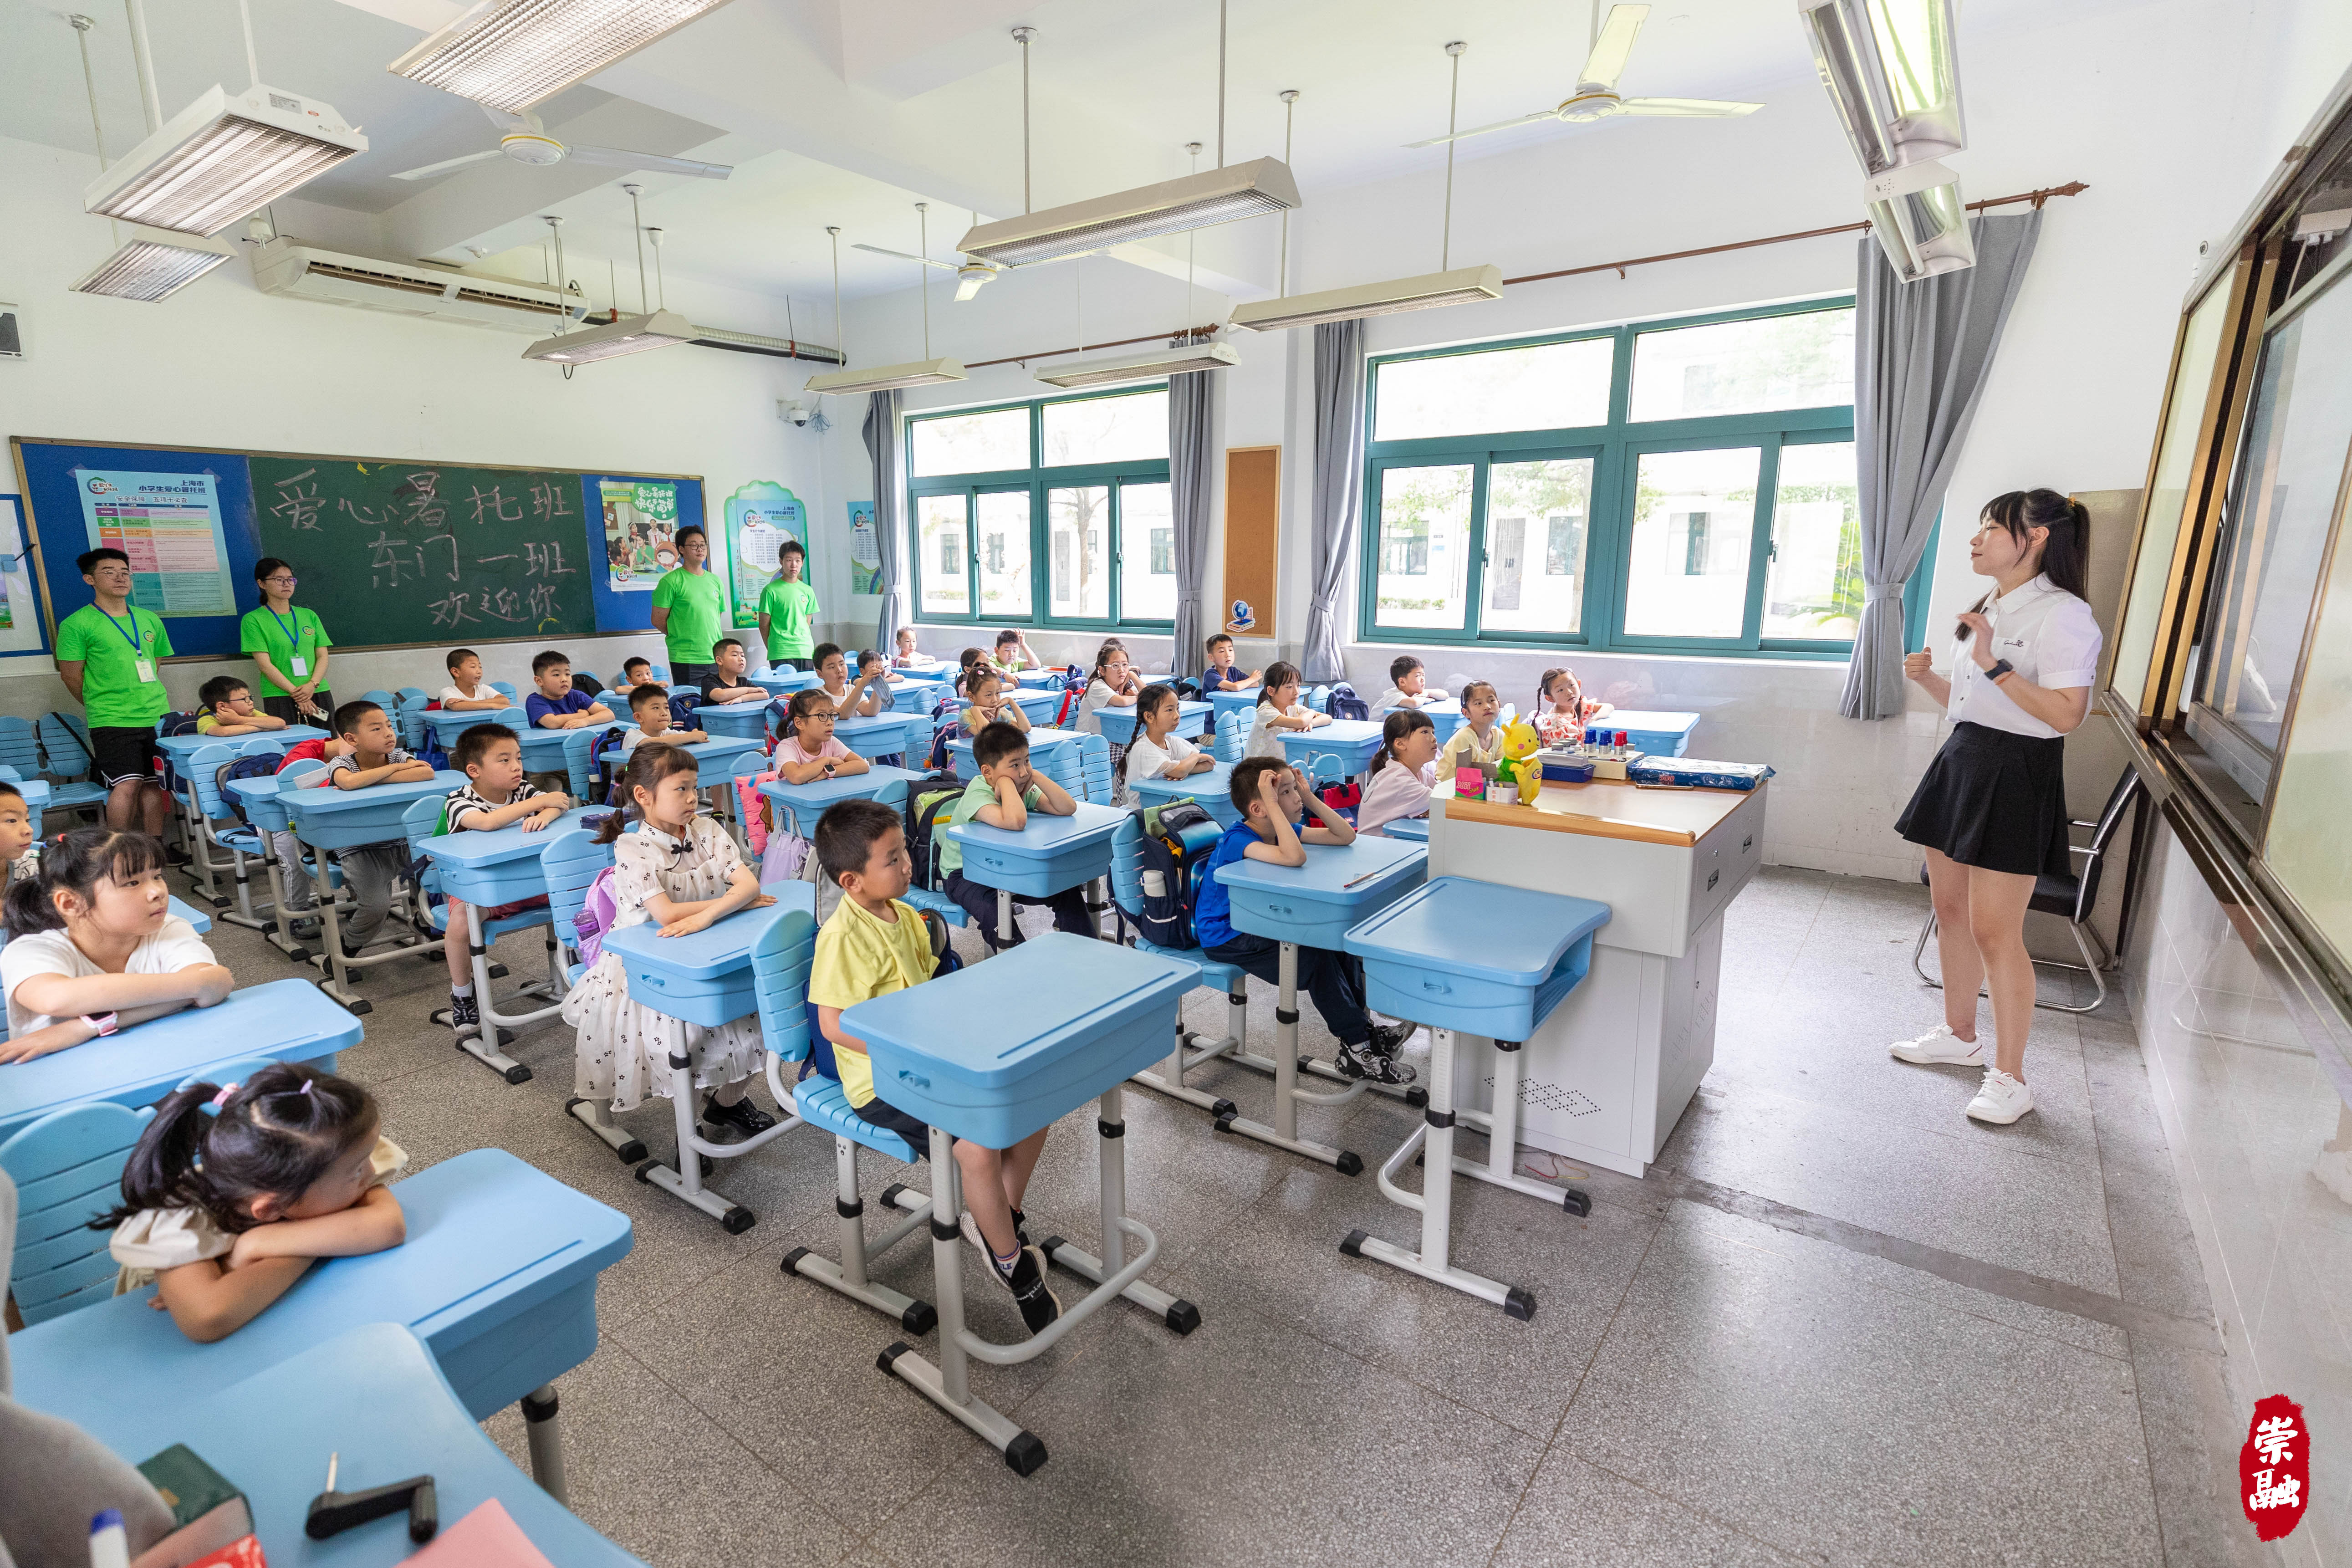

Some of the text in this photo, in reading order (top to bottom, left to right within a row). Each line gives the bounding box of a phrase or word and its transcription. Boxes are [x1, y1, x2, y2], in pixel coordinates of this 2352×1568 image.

[270, 467, 574, 532] 爱心暑托班
[638, 486, 673, 498] 爱心暑托班
[367, 531, 577, 588] 东门一班
[427, 582, 562, 629] 欢迎你
